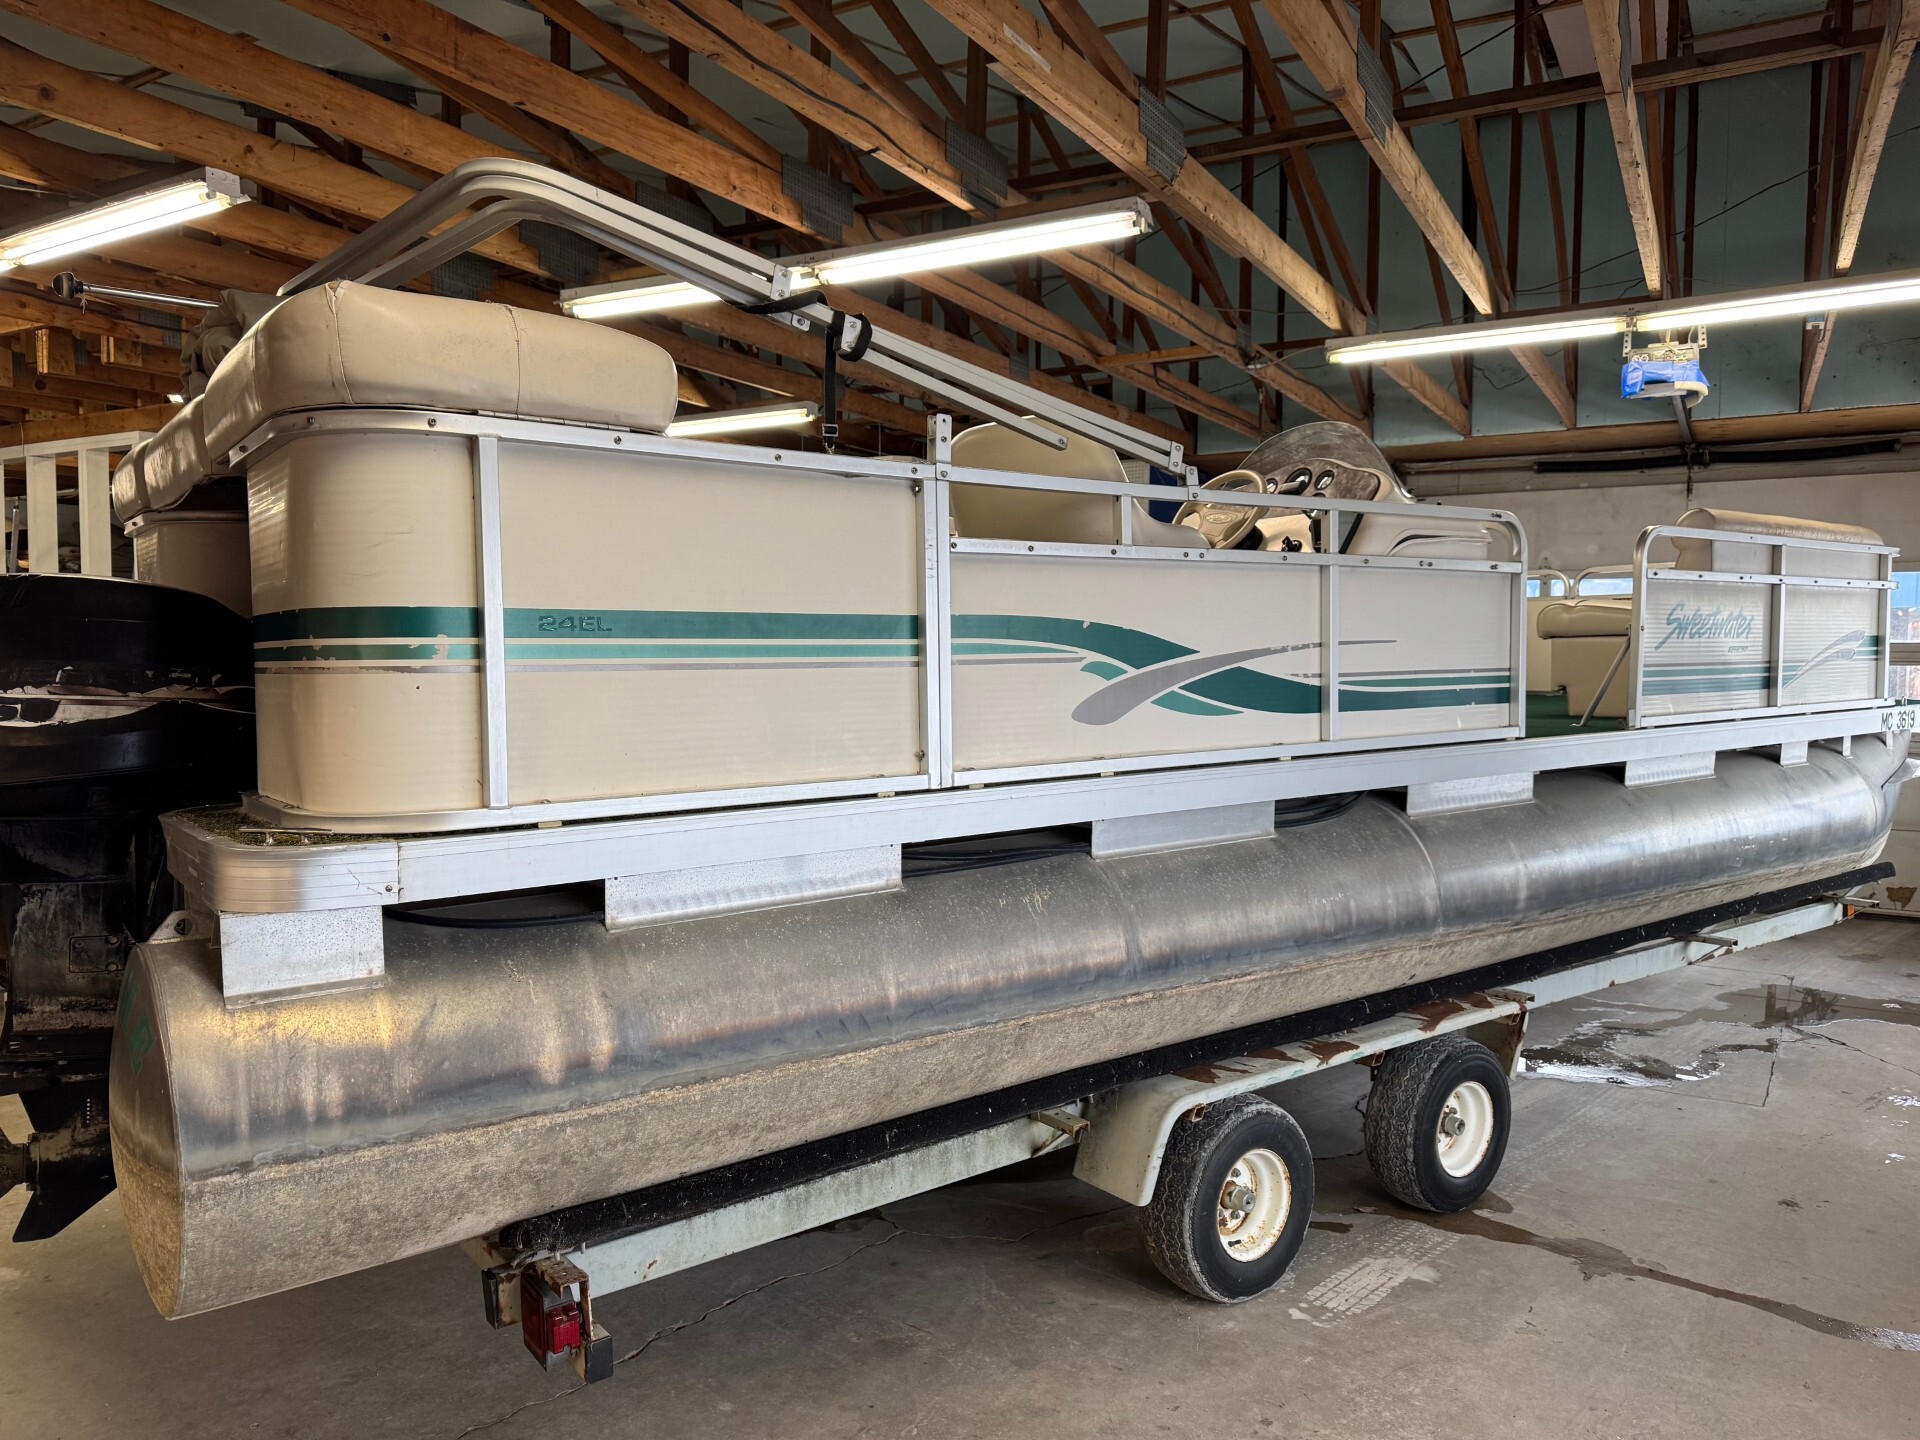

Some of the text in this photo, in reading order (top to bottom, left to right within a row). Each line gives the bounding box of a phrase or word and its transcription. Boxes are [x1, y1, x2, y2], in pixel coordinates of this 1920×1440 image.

[538, 615, 613, 632] 24EL
[1655, 601, 1754, 651] Sweetwater
[1880, 709, 1915, 731] MC 3619
